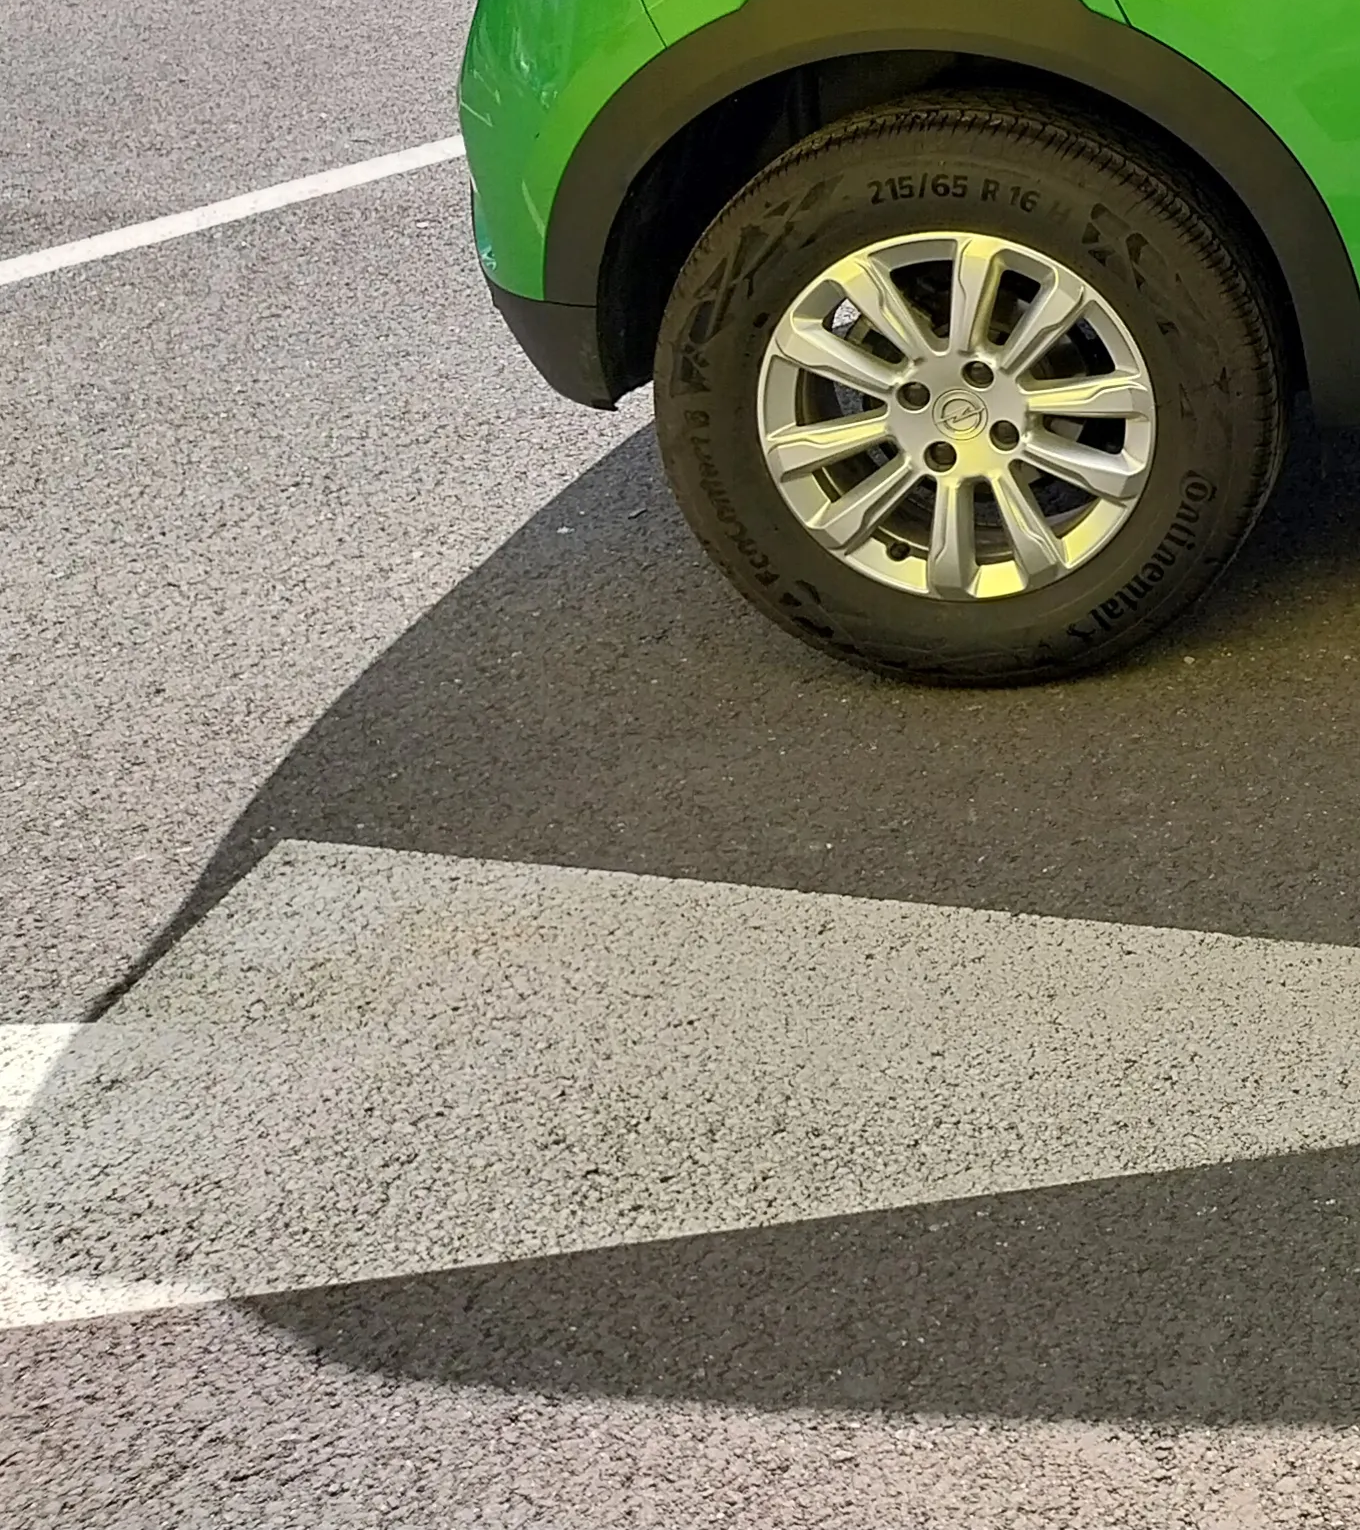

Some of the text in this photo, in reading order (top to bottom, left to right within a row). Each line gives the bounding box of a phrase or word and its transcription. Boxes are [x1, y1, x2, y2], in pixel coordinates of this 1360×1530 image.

[867, 172, 969, 205] 215/65
[980, 178, 1000, 202] R
[1009, 186, 1041, 213] 16
[1087, 470, 1218, 632] Continental
